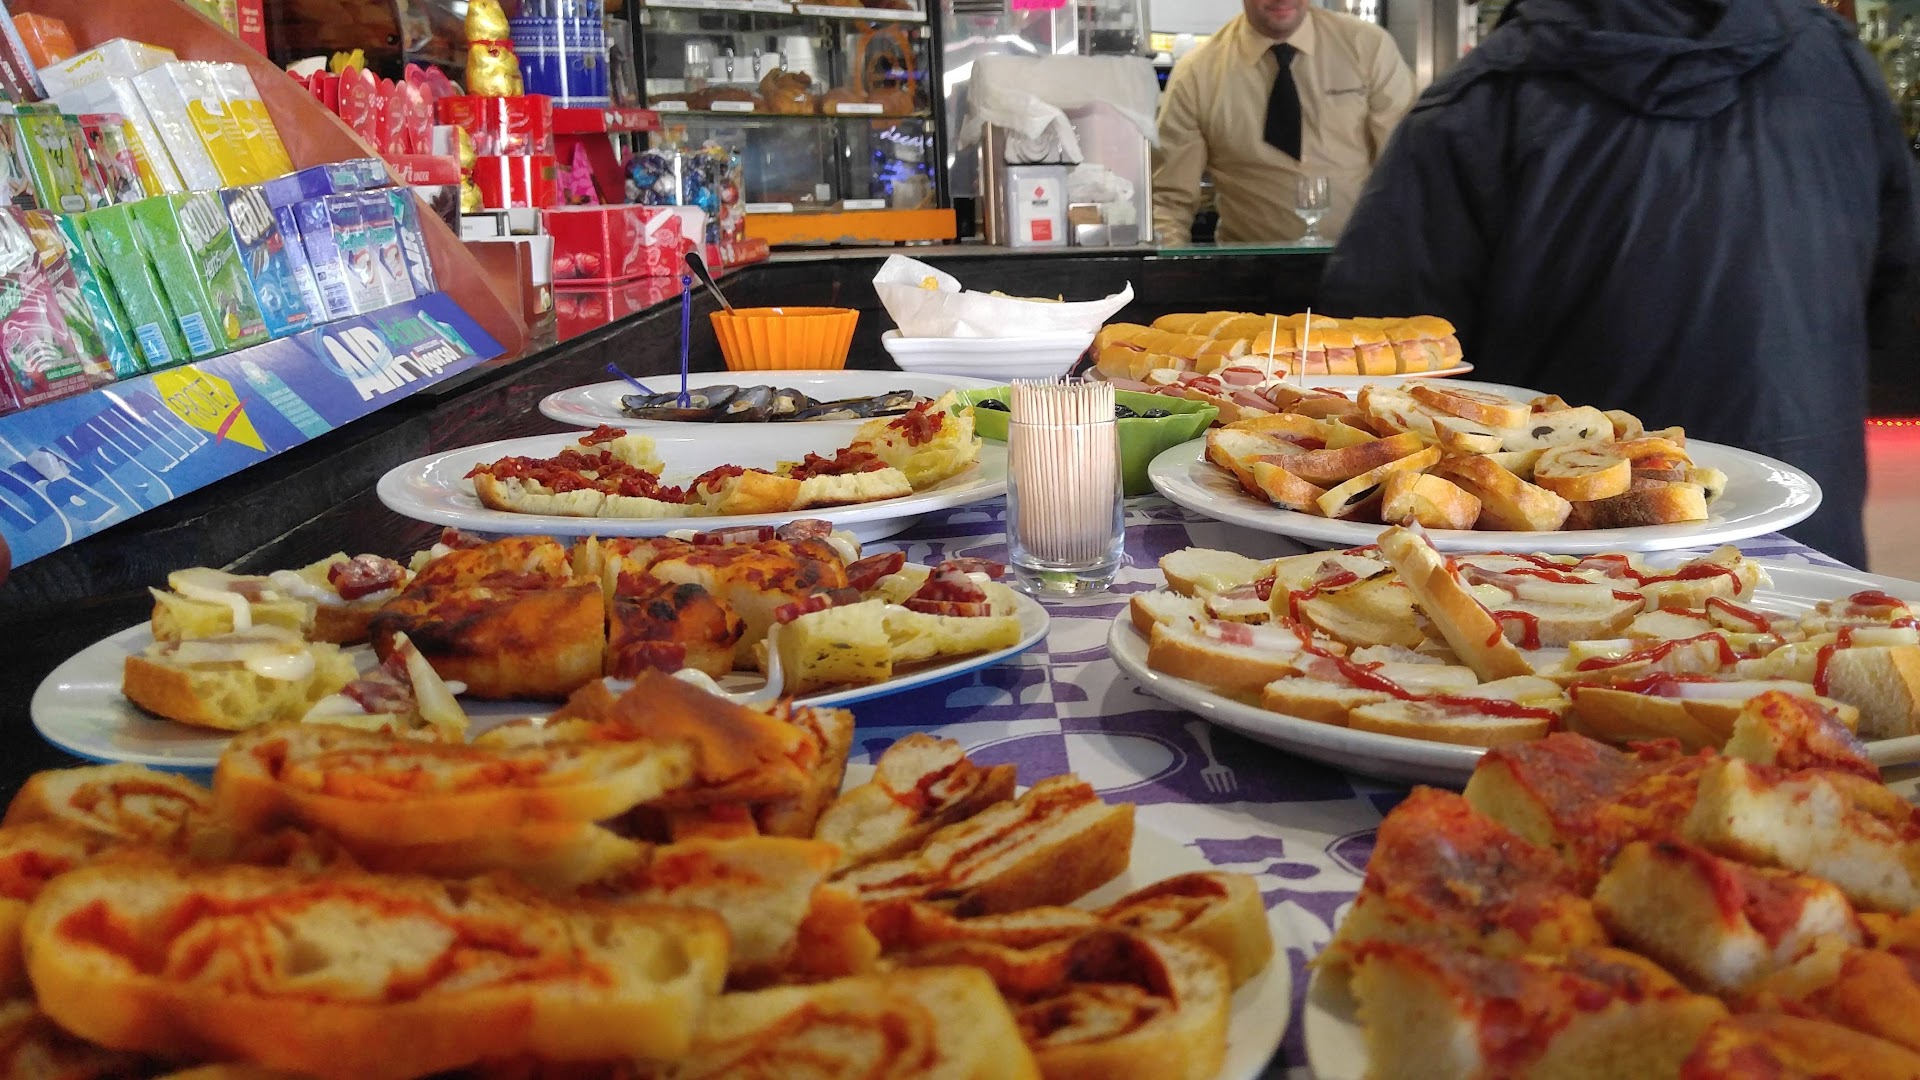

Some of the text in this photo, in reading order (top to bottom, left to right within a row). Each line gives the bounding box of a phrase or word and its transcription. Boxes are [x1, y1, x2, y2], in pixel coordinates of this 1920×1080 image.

[400, 226, 432, 292] AIR
[322, 326, 418, 401] AIR
[409, 339, 462, 378] Vigorsol
